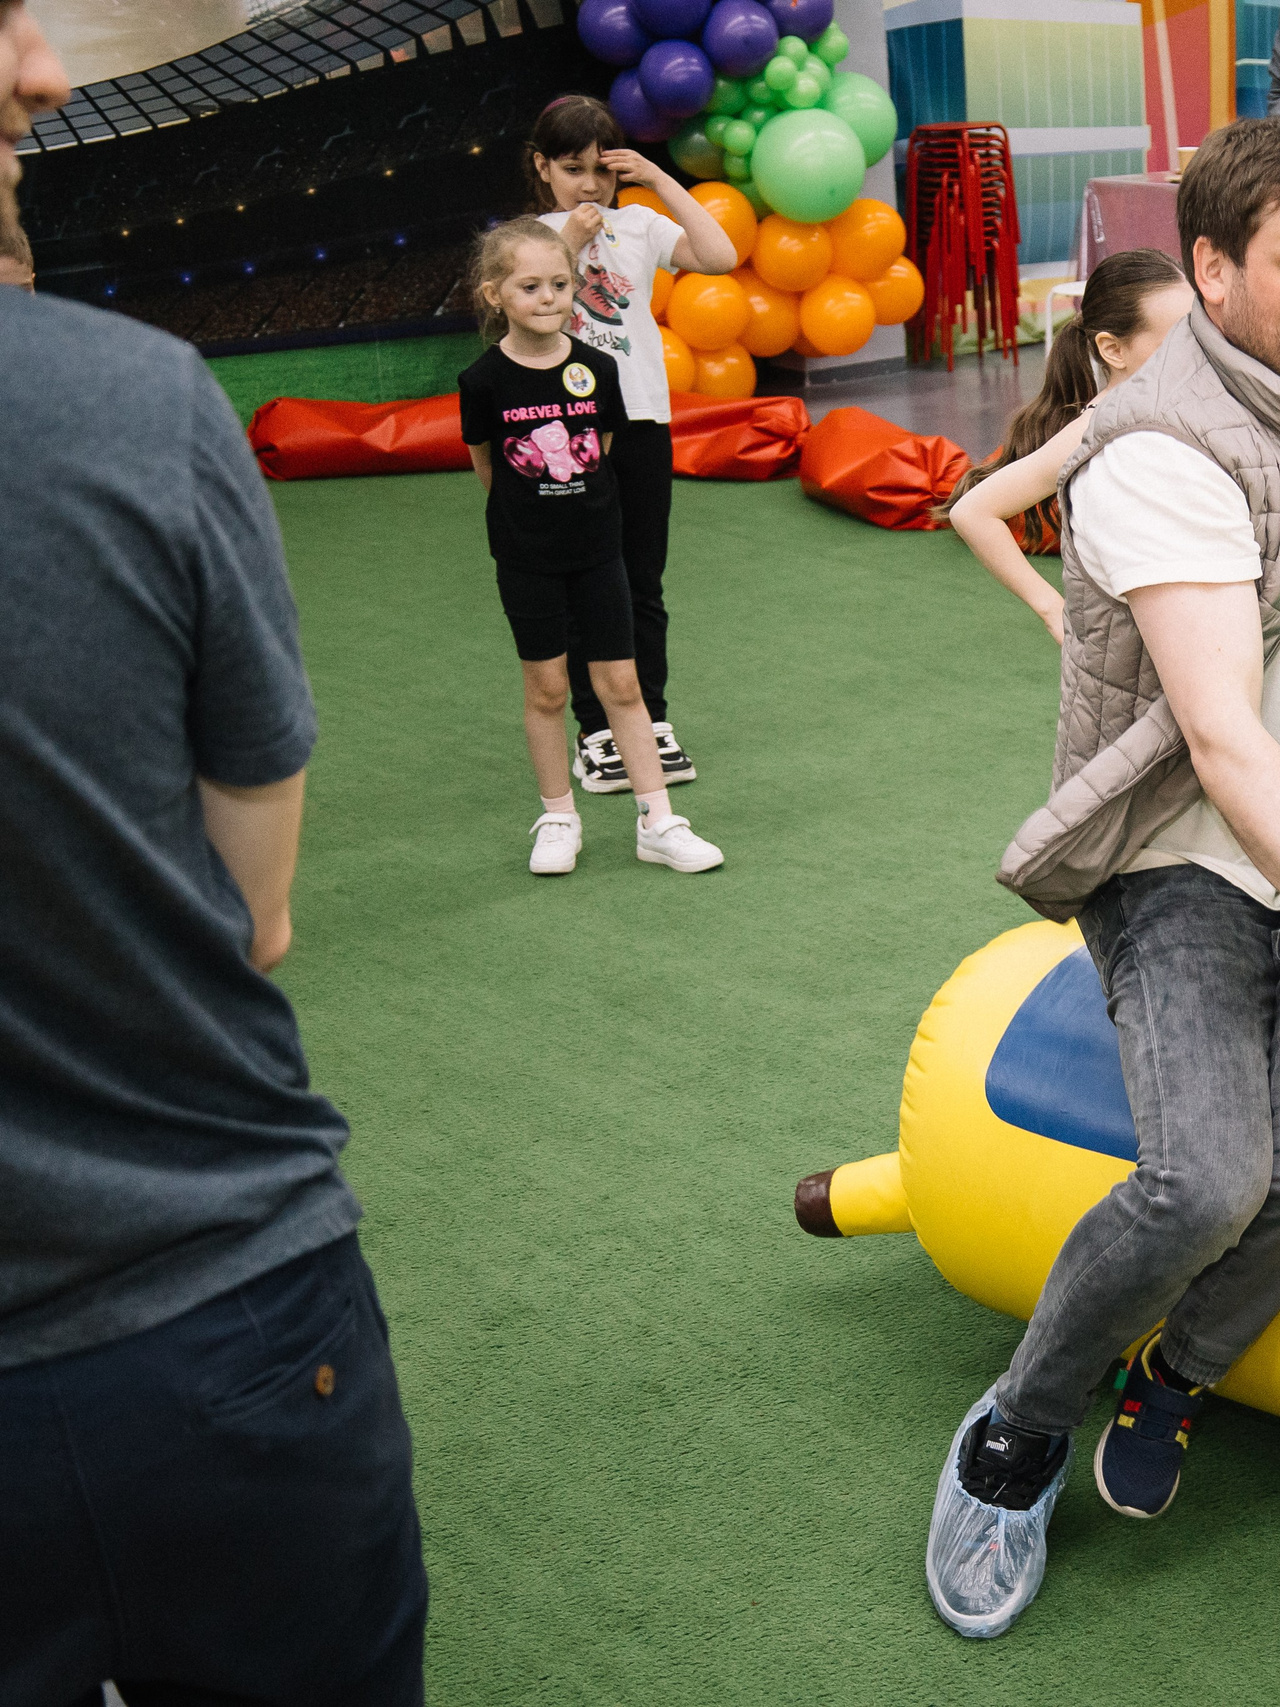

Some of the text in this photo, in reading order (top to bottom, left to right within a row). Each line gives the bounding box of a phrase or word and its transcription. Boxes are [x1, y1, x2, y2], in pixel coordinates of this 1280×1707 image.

[503, 401, 597, 423] FOREVER LOVE
[986, 1440, 1005, 1451] PUMA
